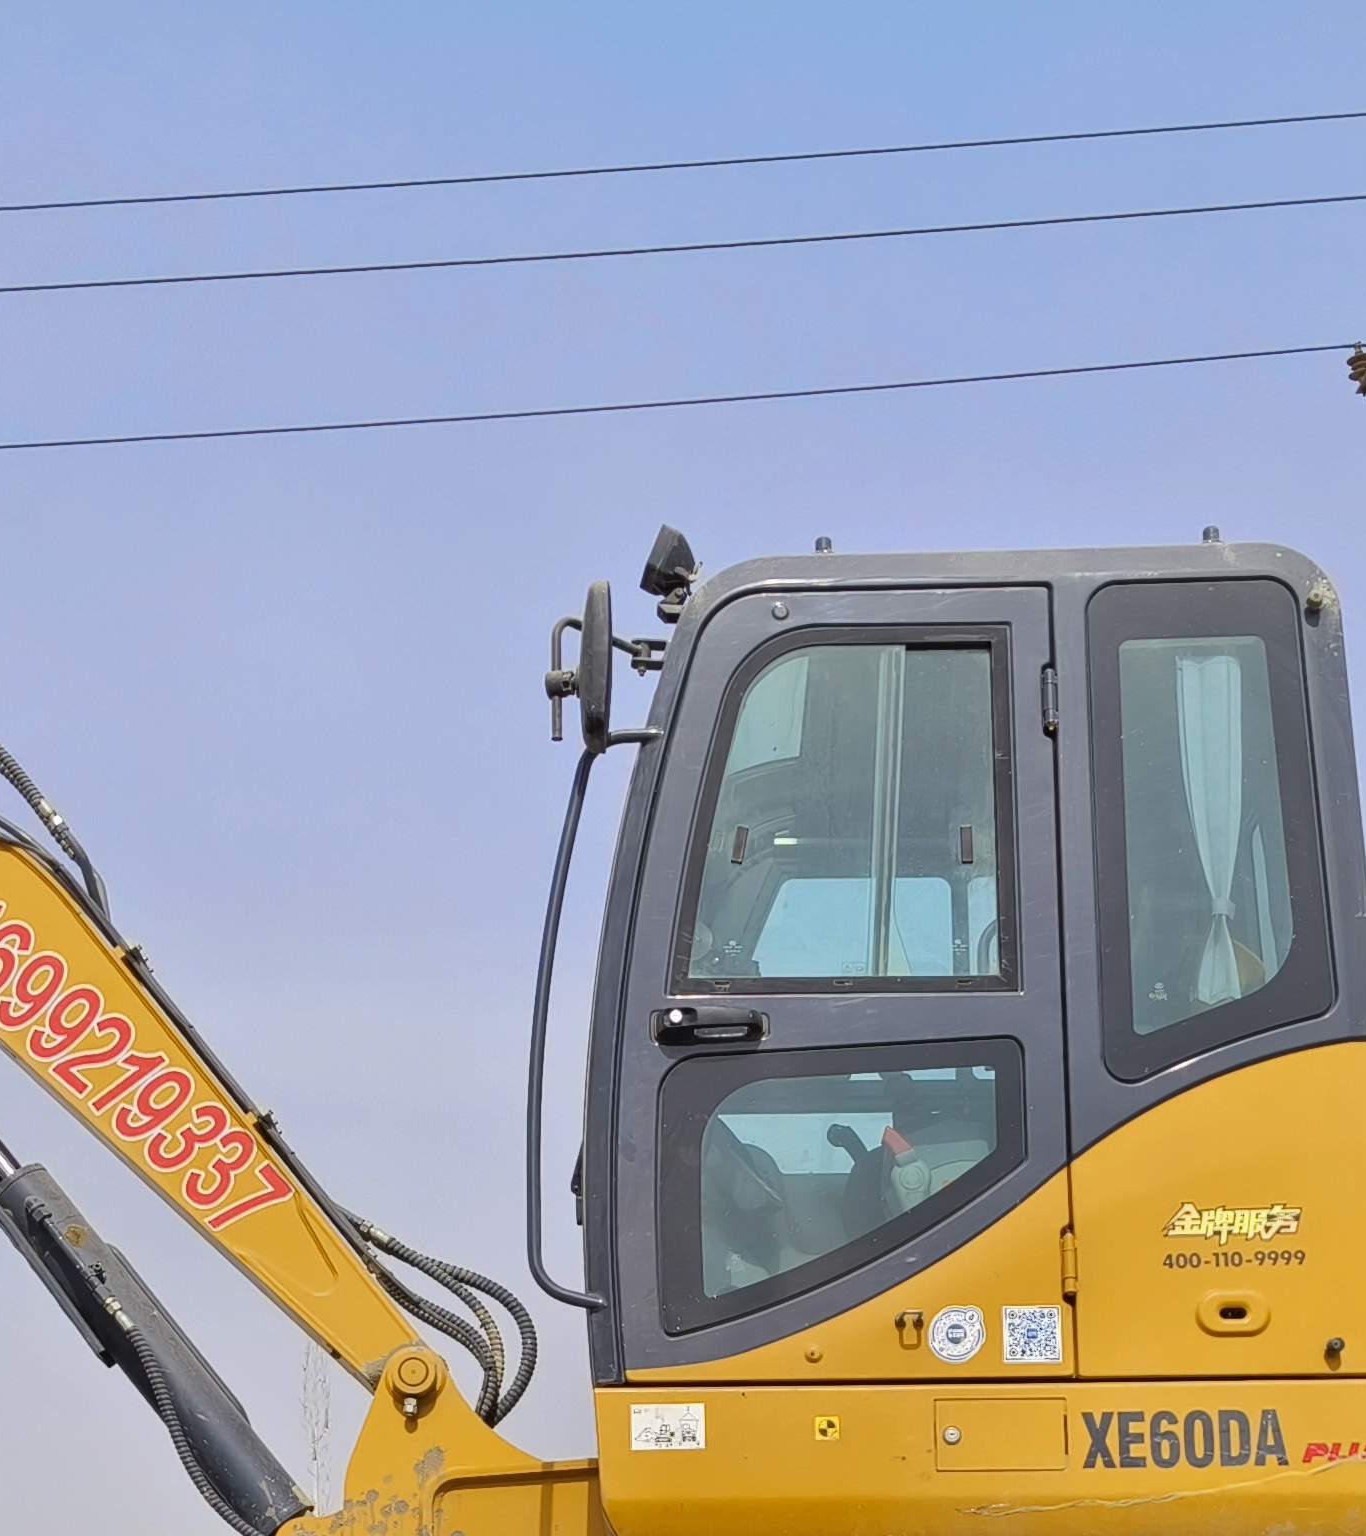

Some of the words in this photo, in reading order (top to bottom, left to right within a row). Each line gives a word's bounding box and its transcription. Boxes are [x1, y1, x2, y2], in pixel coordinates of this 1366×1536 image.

[1161, 1202, 1303, 1246] 金牌服务
[1162, 1250, 1306, 1269] 400-110-9999
[1081, 1409, 1290, 1469] XE60DA
